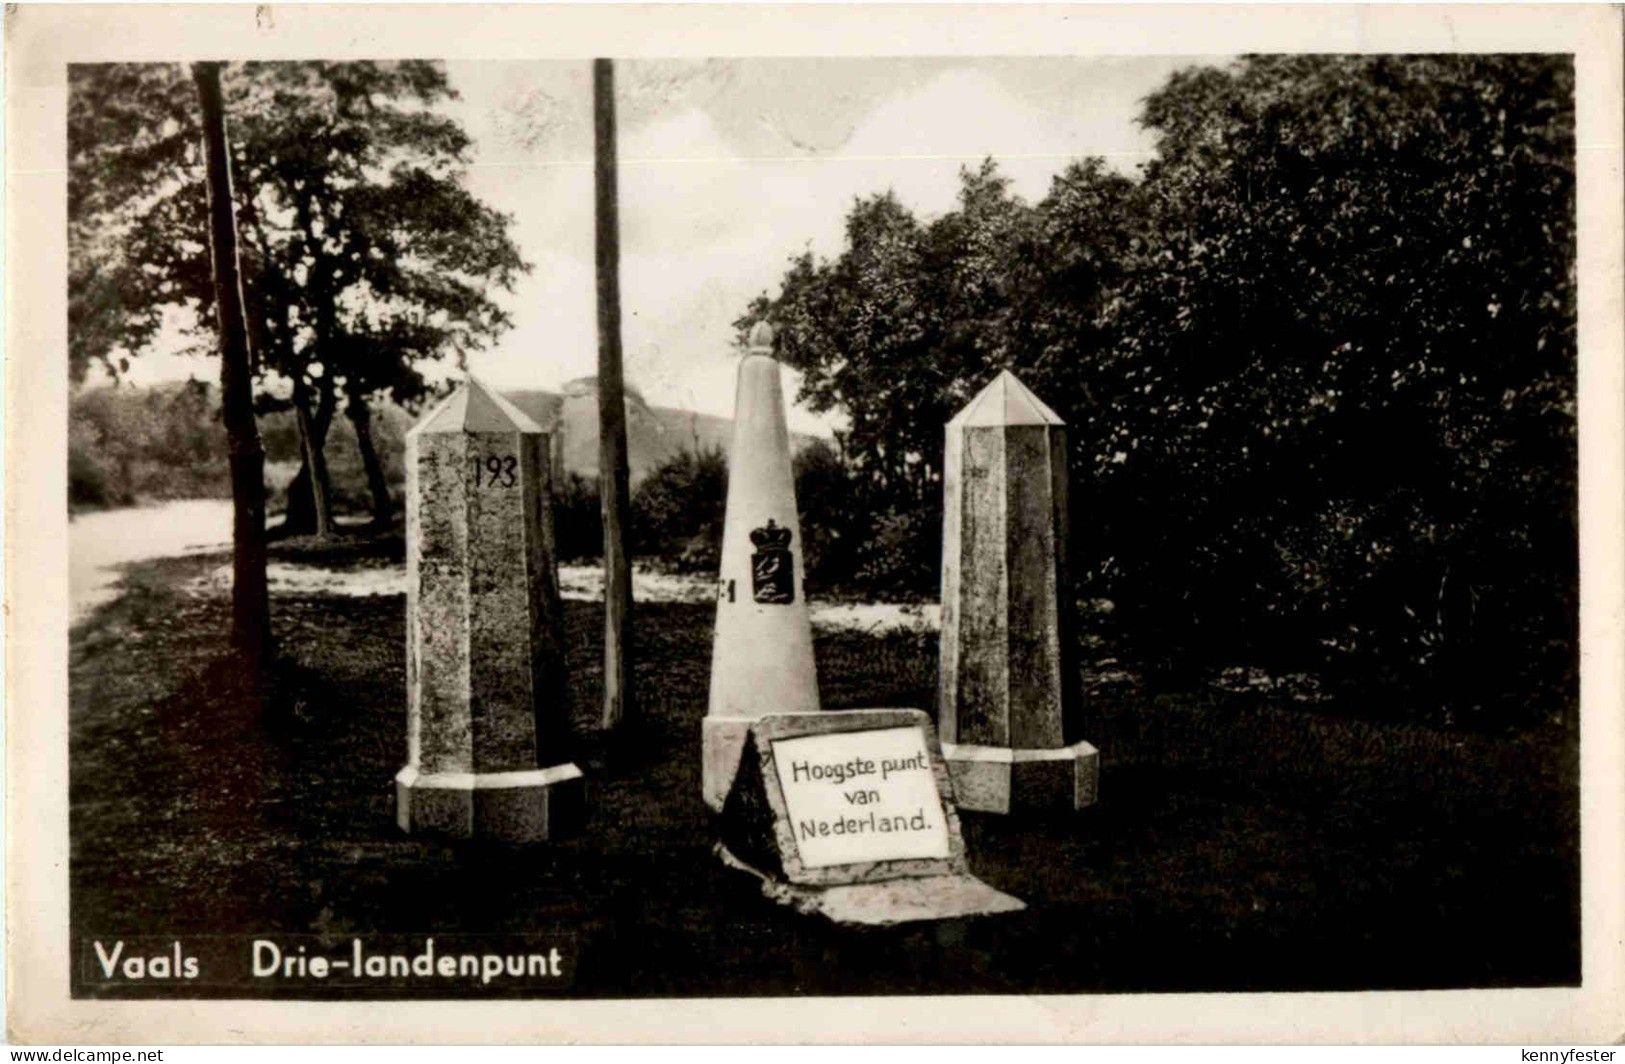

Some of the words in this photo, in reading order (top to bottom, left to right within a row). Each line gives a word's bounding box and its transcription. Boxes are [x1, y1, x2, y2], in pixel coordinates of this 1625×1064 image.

[474, 455, 518, 488] 193
[791, 758, 877, 785] Hoogste
[881, 751, 929, 780] punt
[844, 789, 880, 805] van
[800, 808, 933, 841] Nederland.
